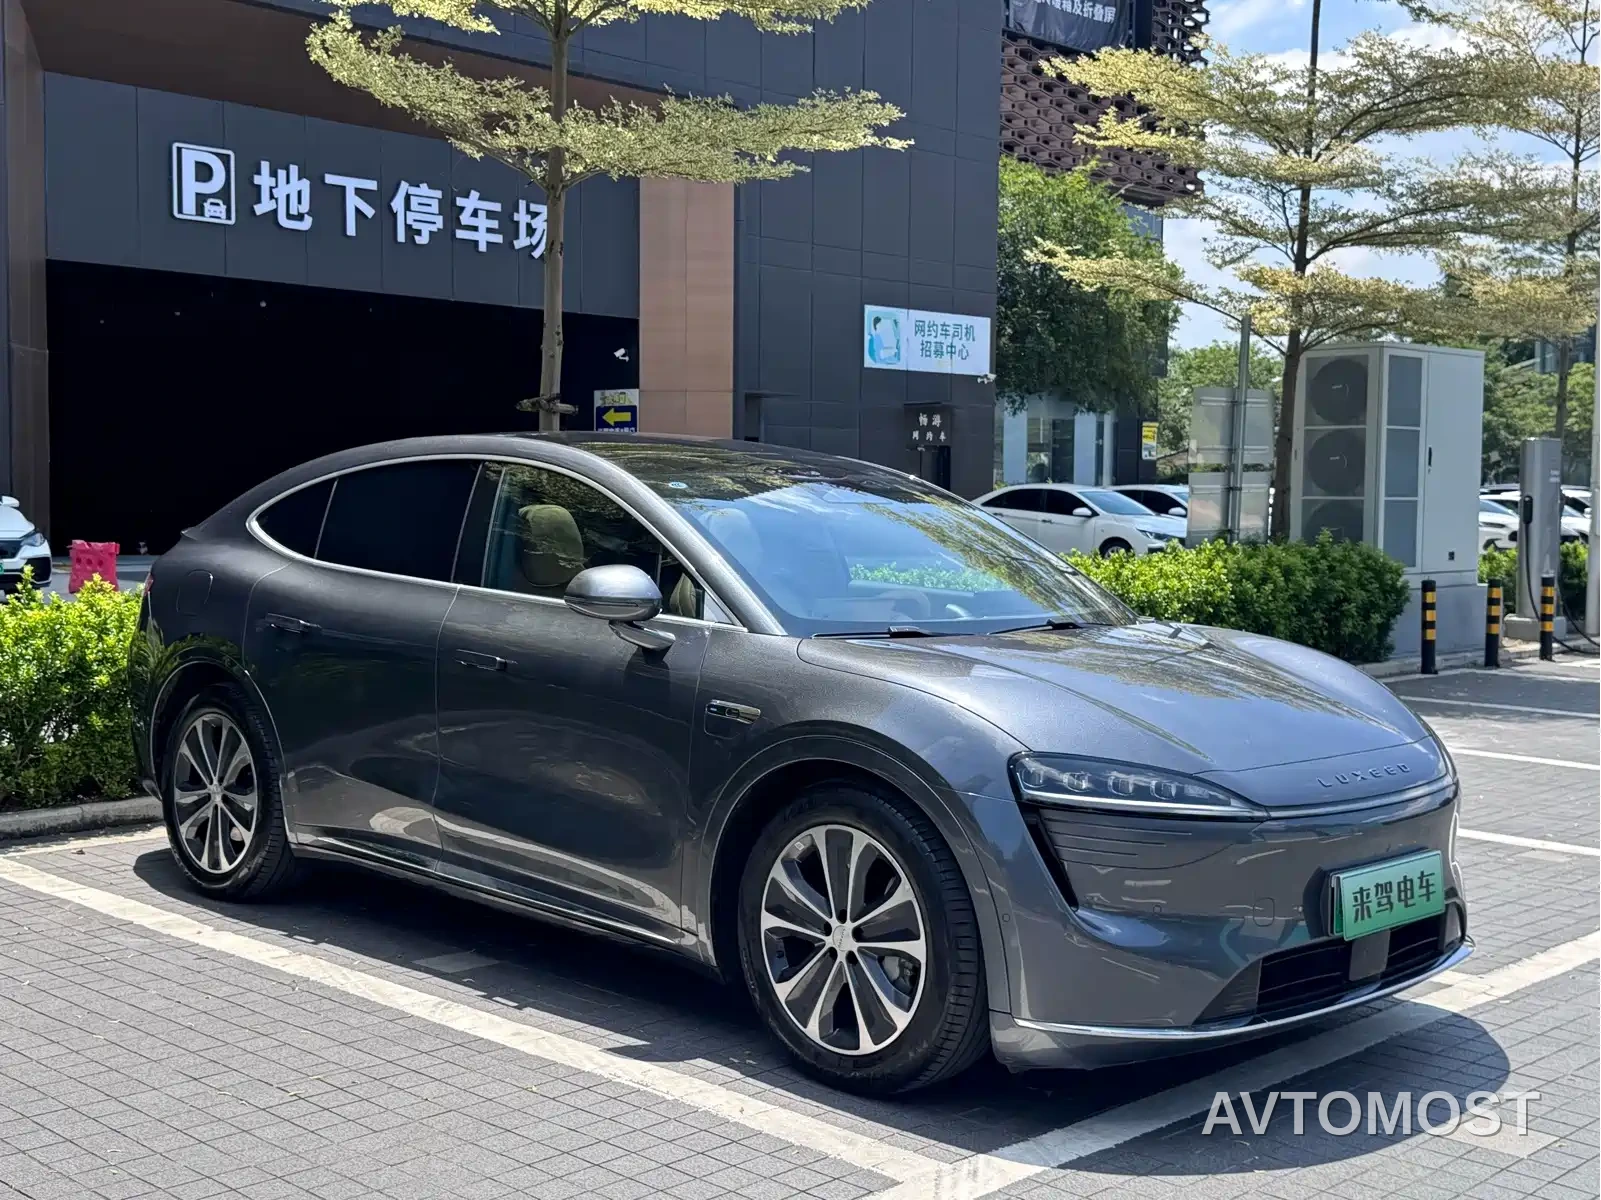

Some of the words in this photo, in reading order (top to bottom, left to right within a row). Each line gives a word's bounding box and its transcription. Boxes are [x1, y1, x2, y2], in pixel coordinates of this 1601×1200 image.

[181, 147, 226, 214] P
[252, 160, 548, 259] 地下停车场
[914, 319, 976, 342] 网约车司机
[920, 340, 969, 361] 招募中心
[1316, 762, 1411, 788] LUXEED
[1352, 870, 1437, 924] 来驾电车
